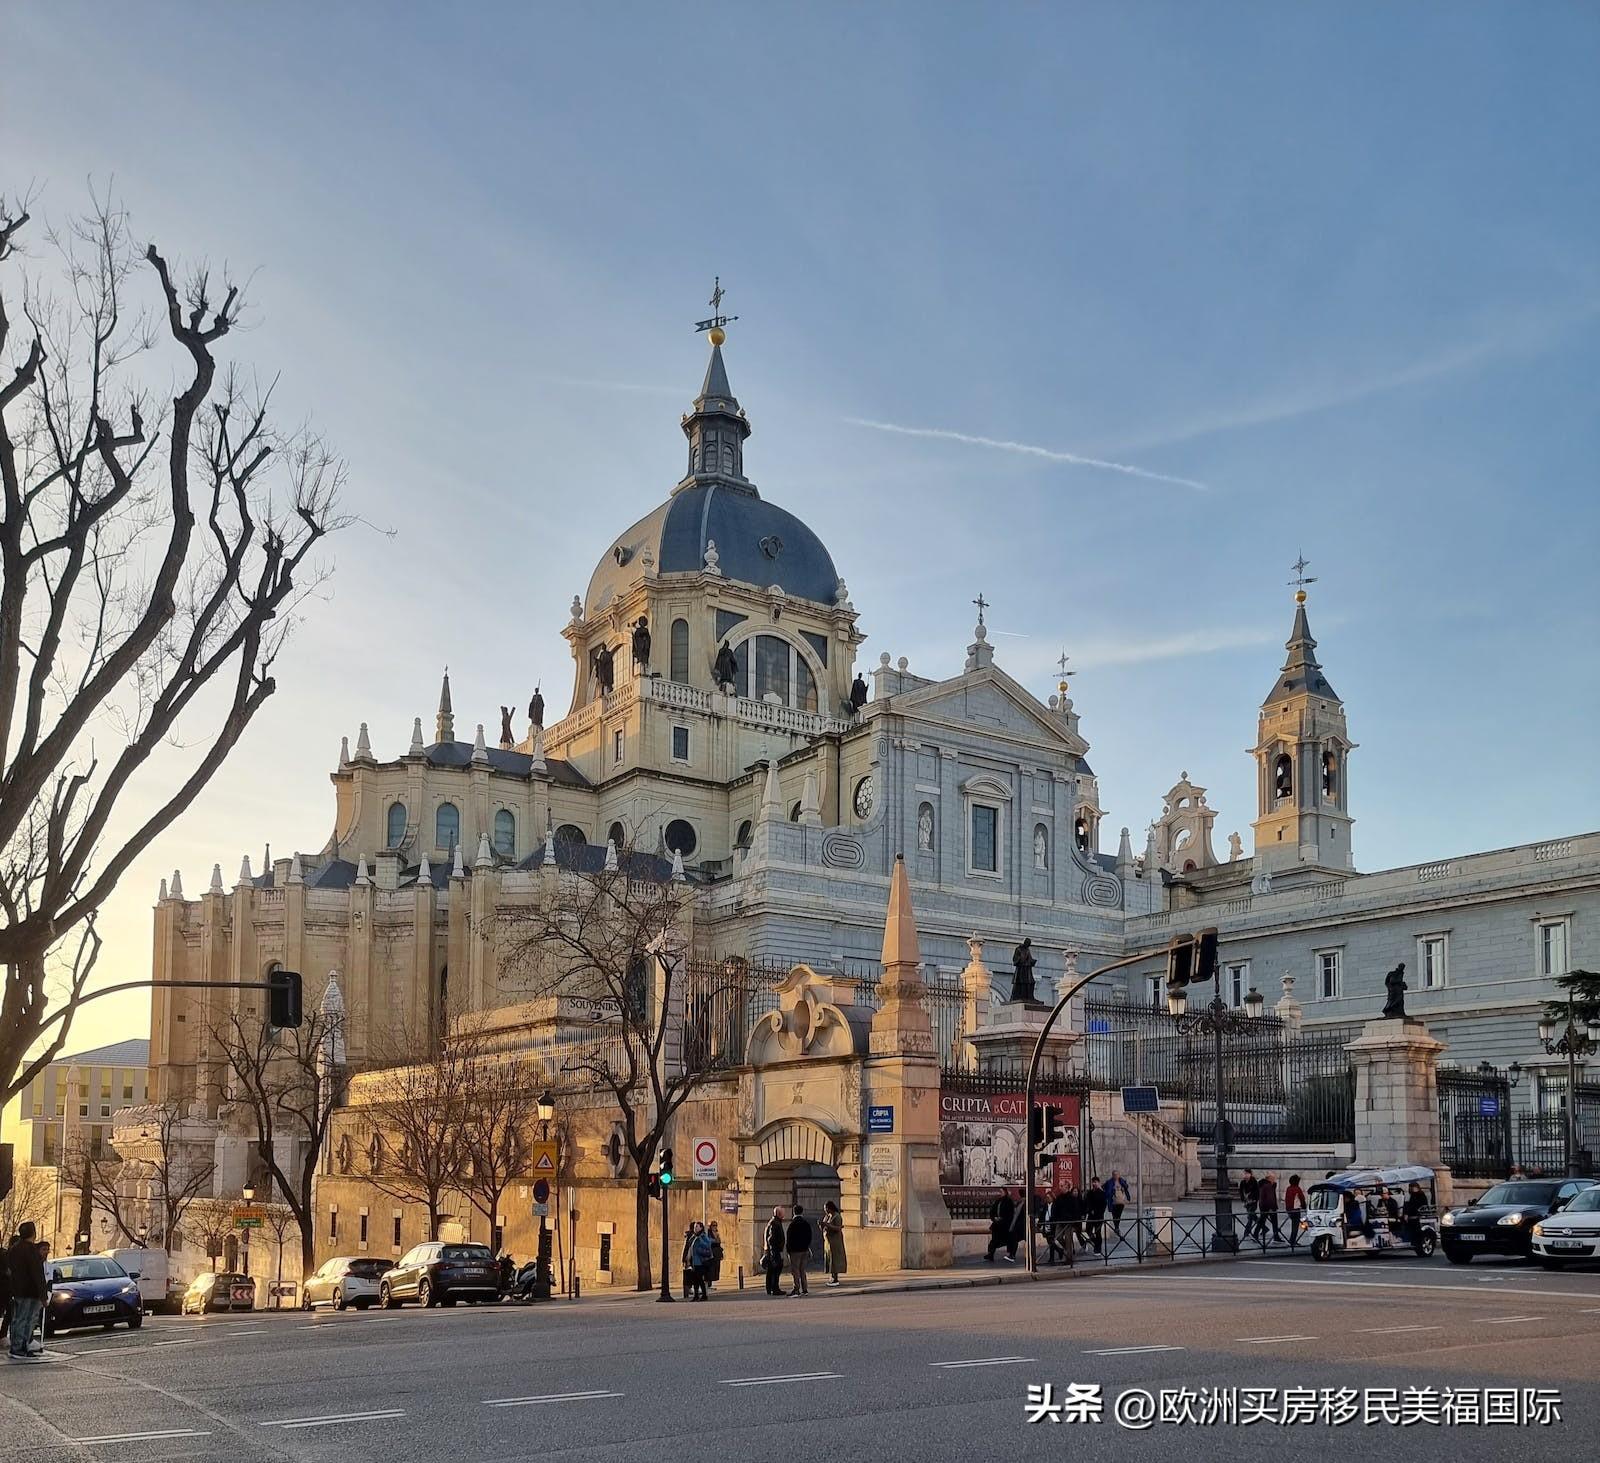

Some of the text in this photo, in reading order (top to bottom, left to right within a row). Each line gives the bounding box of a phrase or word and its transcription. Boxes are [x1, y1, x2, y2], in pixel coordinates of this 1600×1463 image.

[570, 998, 619, 1012] SOUVENIRS
[942, 1096, 991, 1113] CRIPTA
[872, 1109, 889, 1117] CRIPTA
[1058, 1161, 1073, 1170] 400
